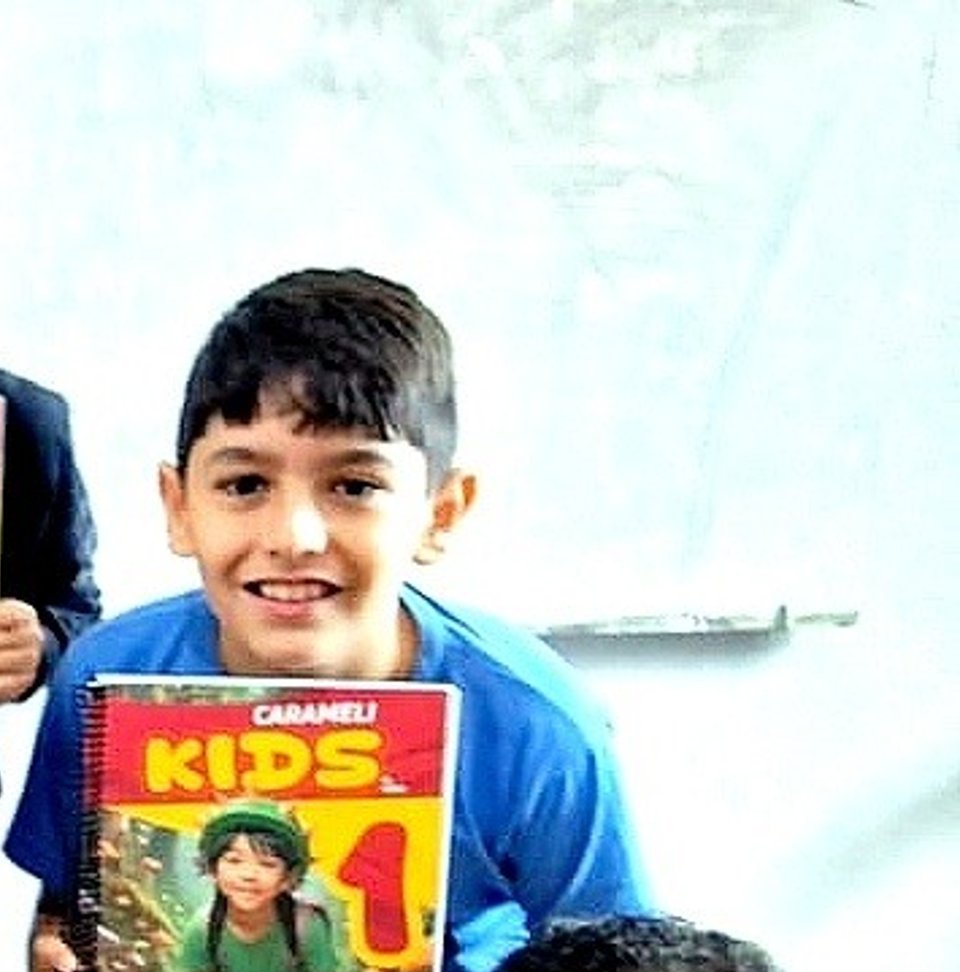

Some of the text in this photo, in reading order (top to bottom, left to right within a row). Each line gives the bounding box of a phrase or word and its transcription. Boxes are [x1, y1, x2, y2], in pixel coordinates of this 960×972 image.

[252, 701, 378, 726] CARAMELI
[145, 730, 382, 793] KIDS
[341, 821, 410, 955] 1
